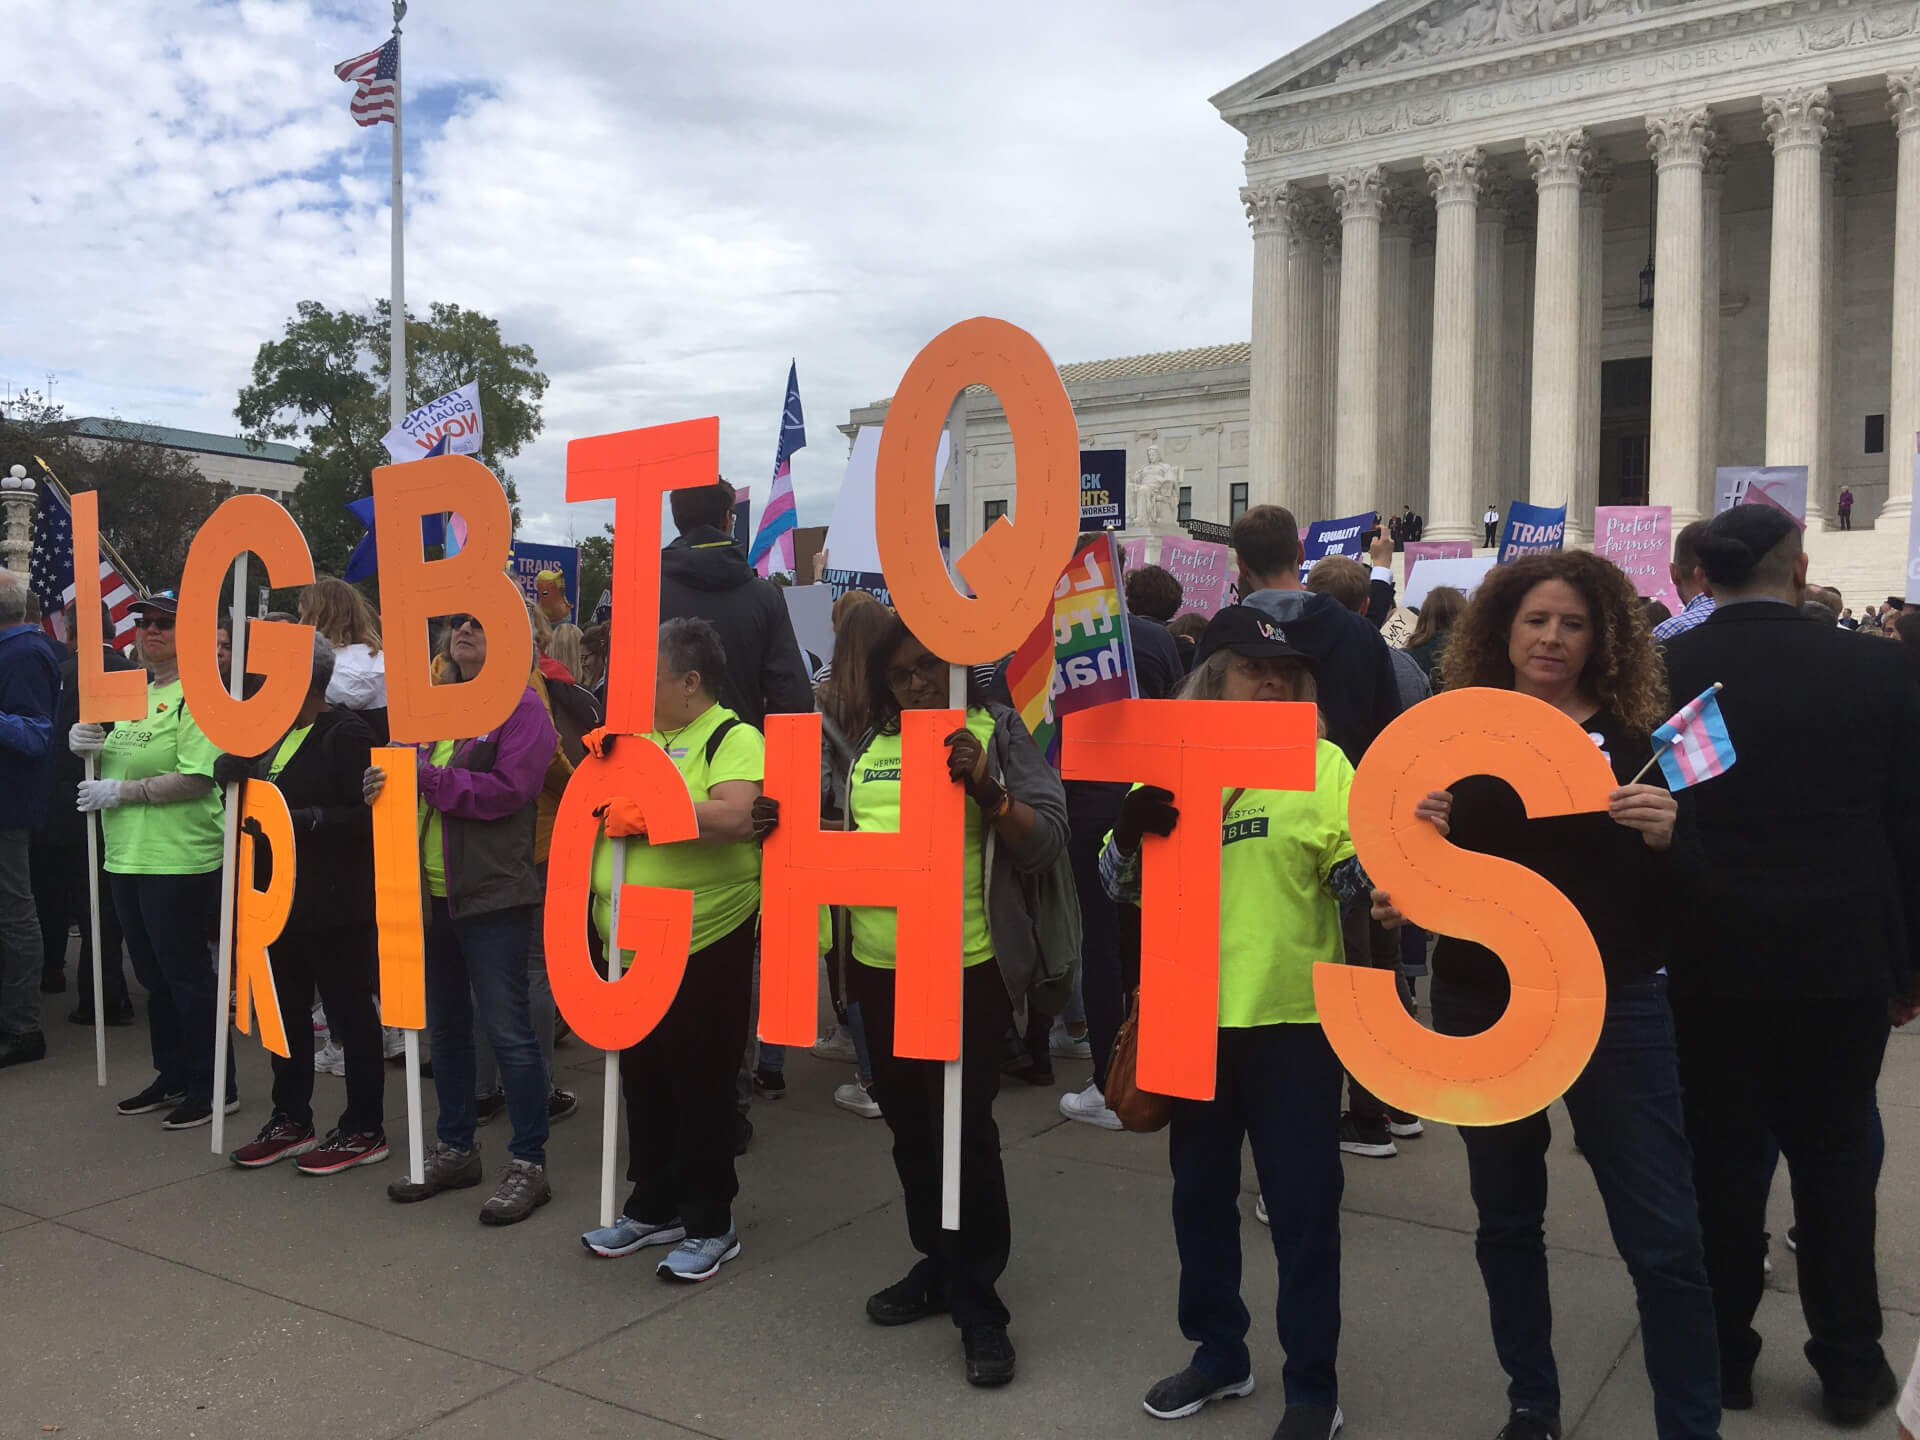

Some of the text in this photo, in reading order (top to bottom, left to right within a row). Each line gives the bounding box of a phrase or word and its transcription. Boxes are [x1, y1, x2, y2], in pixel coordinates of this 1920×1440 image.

[1466, 37, 1779, 111] EQUAL JUSTICE UNDER LAW
[1081, 505, 1116, 516] WORKERS
[1318, 526, 1360, 543] EQUALITY
[1512, 521, 1563, 543] TRANS
[1325, 543, 1344, 556] FOR
[518, 558, 561, 574] TRANS
[136, 731, 152, 742] 93
